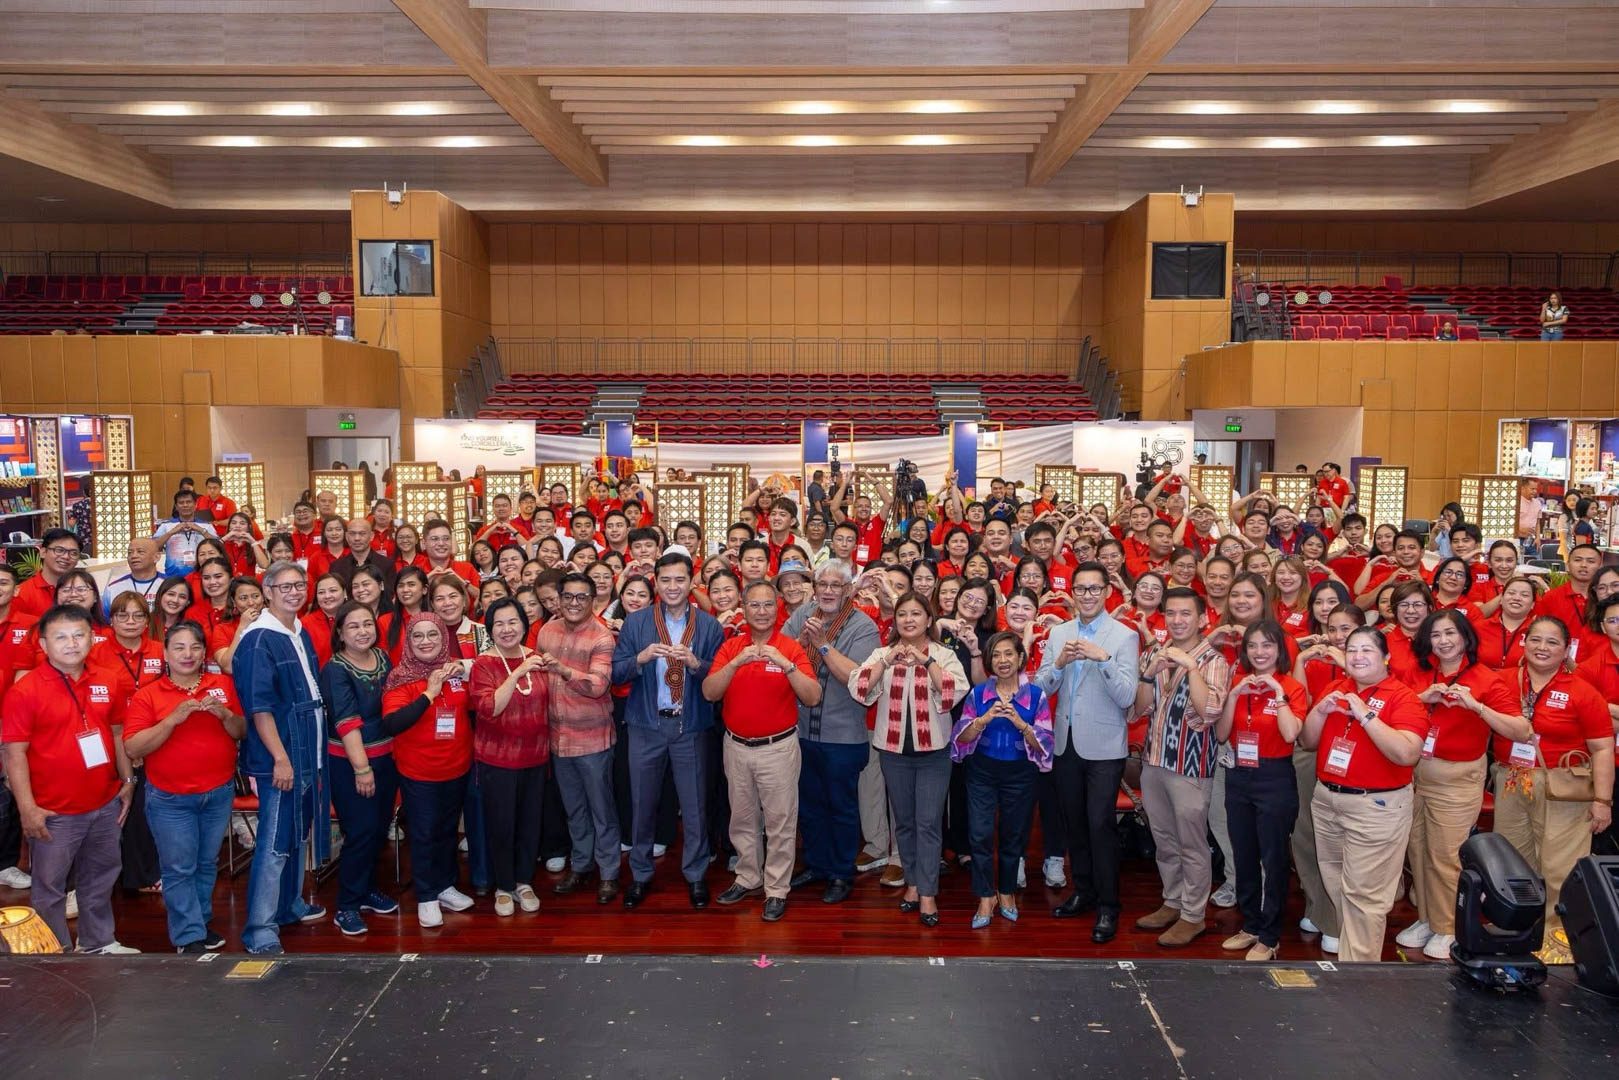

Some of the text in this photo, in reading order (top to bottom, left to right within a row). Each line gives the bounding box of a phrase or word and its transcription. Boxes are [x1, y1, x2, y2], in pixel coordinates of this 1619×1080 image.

[143, 659, 161, 667] TPB
[90, 685, 108, 694] TPB
[206, 688, 225, 697] TPB
[1550, 690, 1569, 702] TPB
[1368, 697, 1385, 709] TPB
